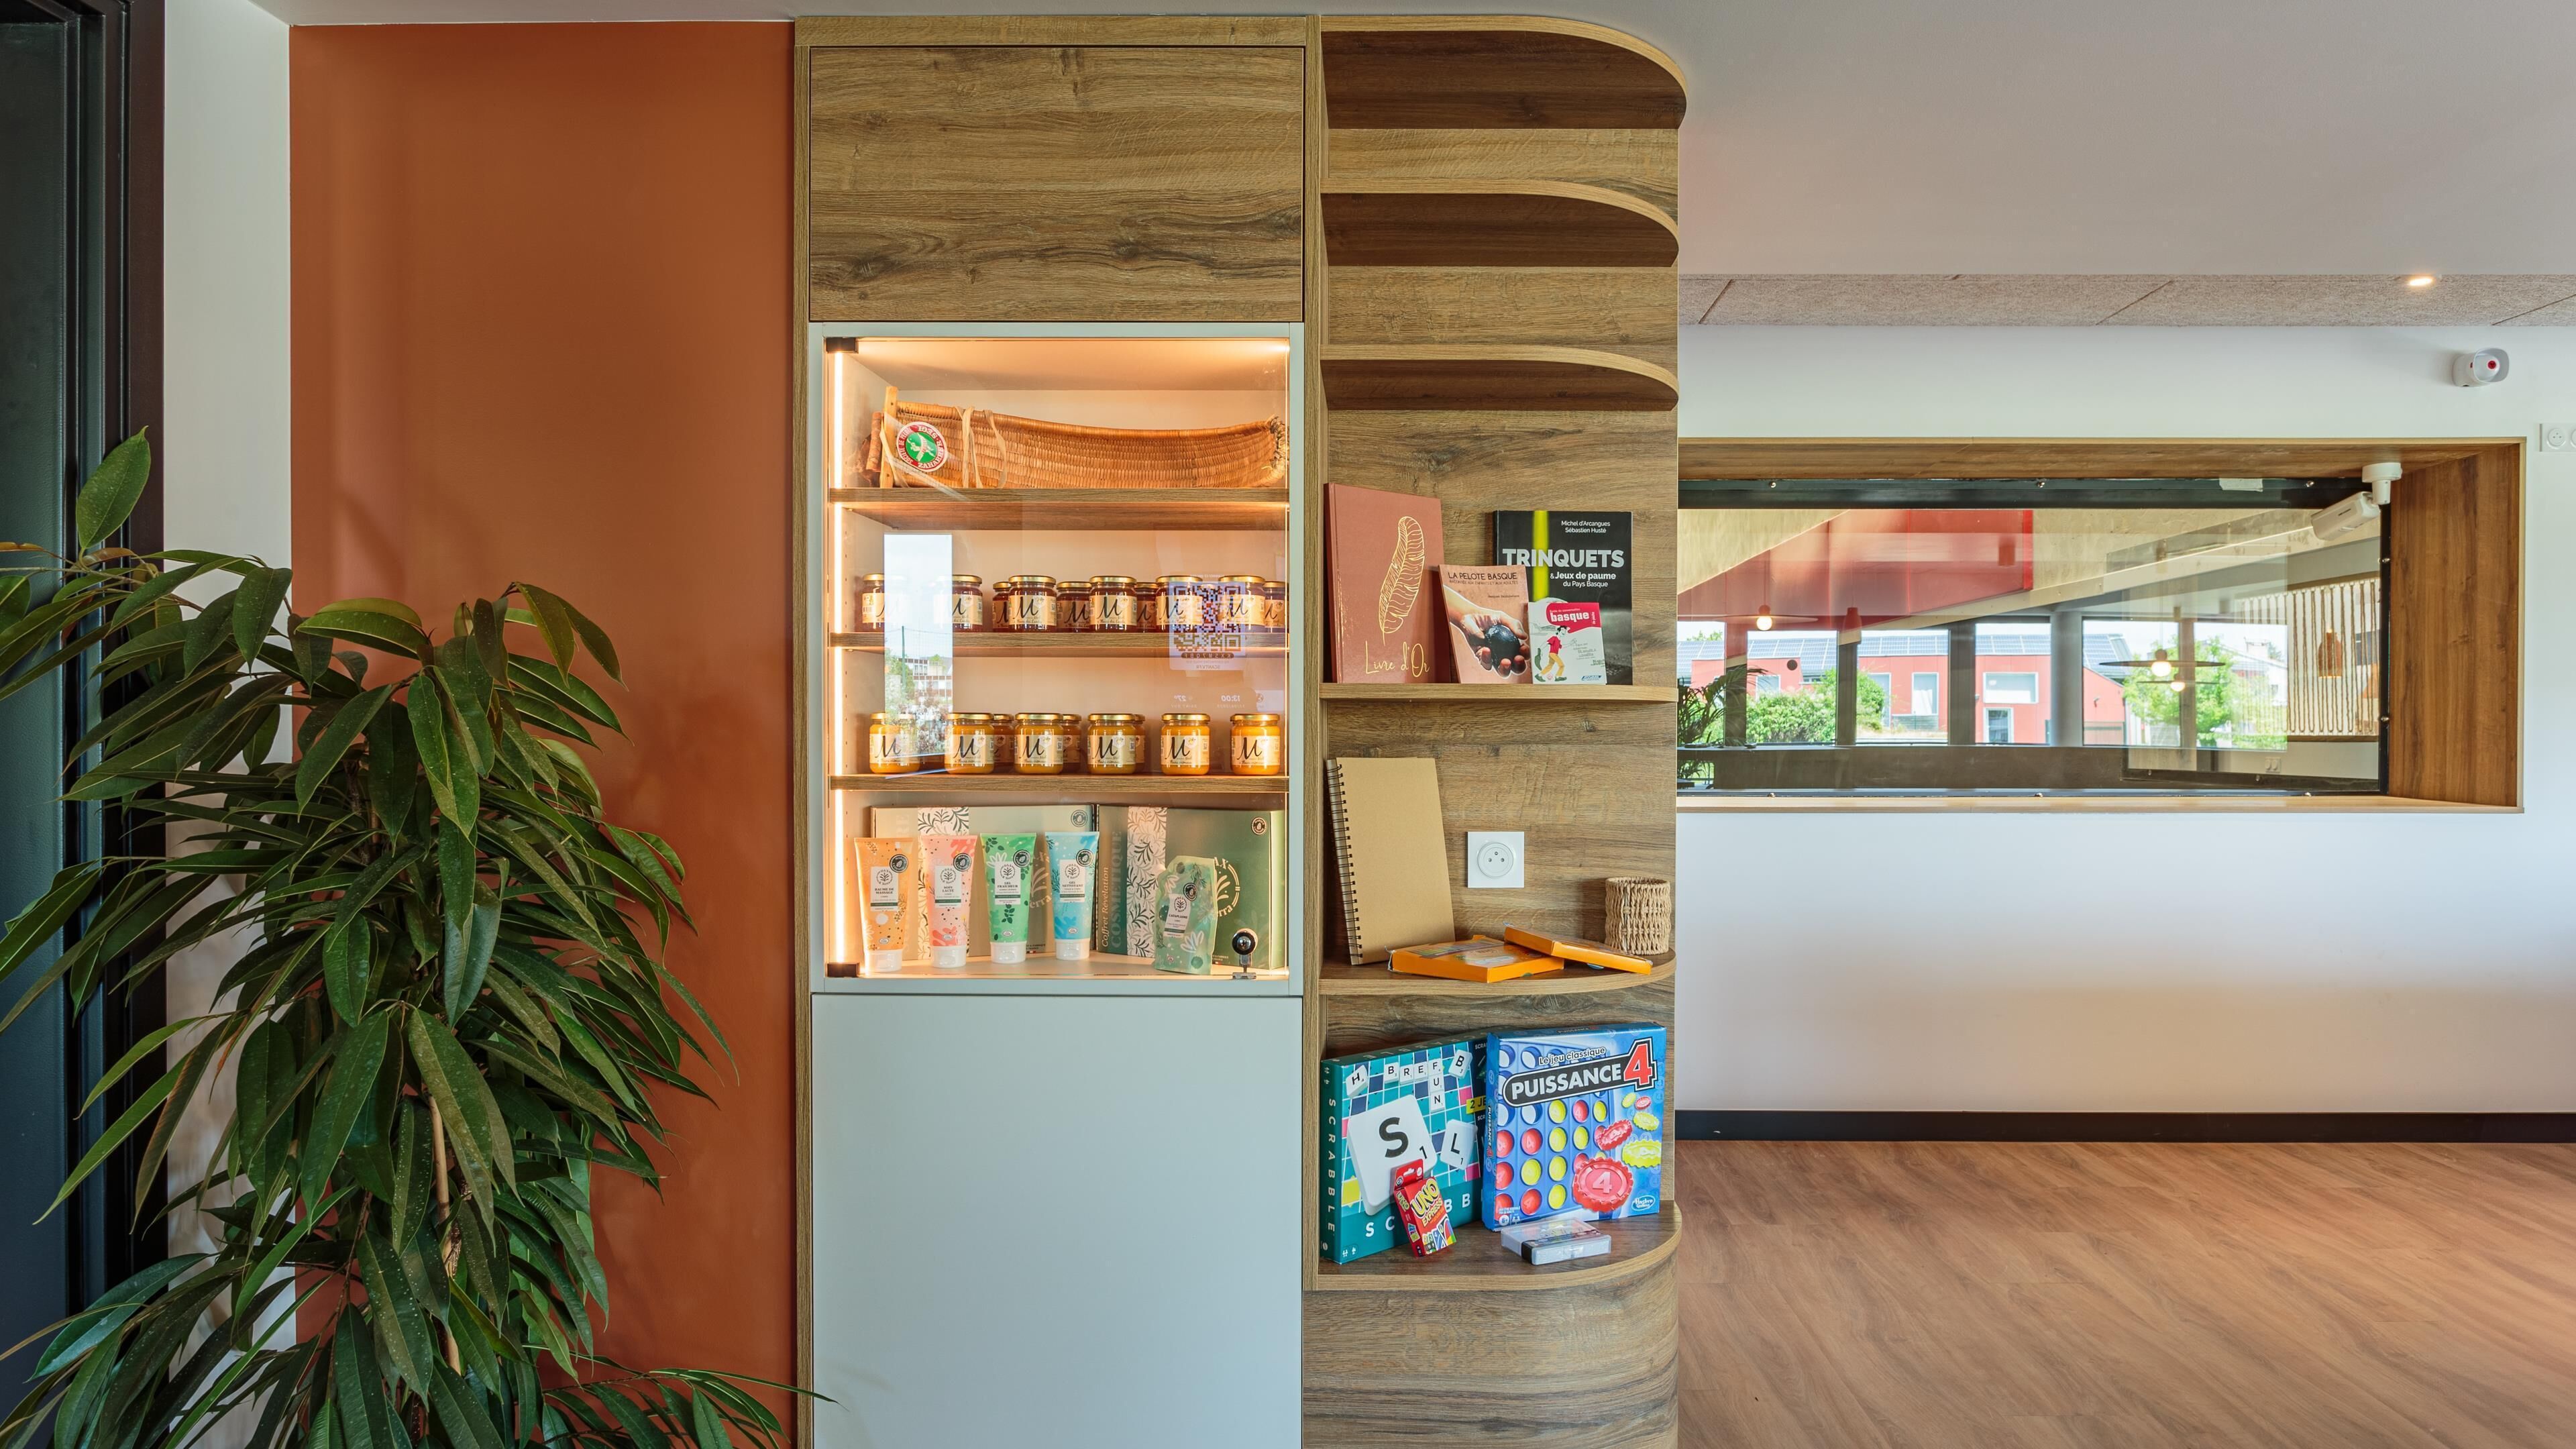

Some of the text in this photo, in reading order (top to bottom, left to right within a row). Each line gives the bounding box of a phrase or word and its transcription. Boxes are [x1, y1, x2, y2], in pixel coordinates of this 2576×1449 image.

[1502, 548, 1625, 568] TRINQUETS
[1459, 572, 1485, 580] PELOTE
[1487, 572, 1518, 580] BASQUE
[1555, 572, 1574, 580] Jeux
[1588, 572, 1616, 581] paume
[1550, 612, 1590, 623] basque
[1365, 640, 1430, 678] Livre d'Or
[1214, 857, 1228, 870] AX
[1455, 1055, 1464, 1067] B
[1539, 1046, 1606, 1066] Le jeu classique
[1511, 1041, 1654, 1100] PUISSANCE 4
[1470, 1100, 1475, 1109] 2
[1379, 1117, 1409, 1158] S
[1450, 1133, 1460, 1155] L
[1328, 1098, 1336, 1232] SCRABBLE
[1593, 1171, 1613, 1195] 4
[1410, 1179, 1440, 1218] UNO
[1421, 1197, 1444, 1227] EXPRESS
